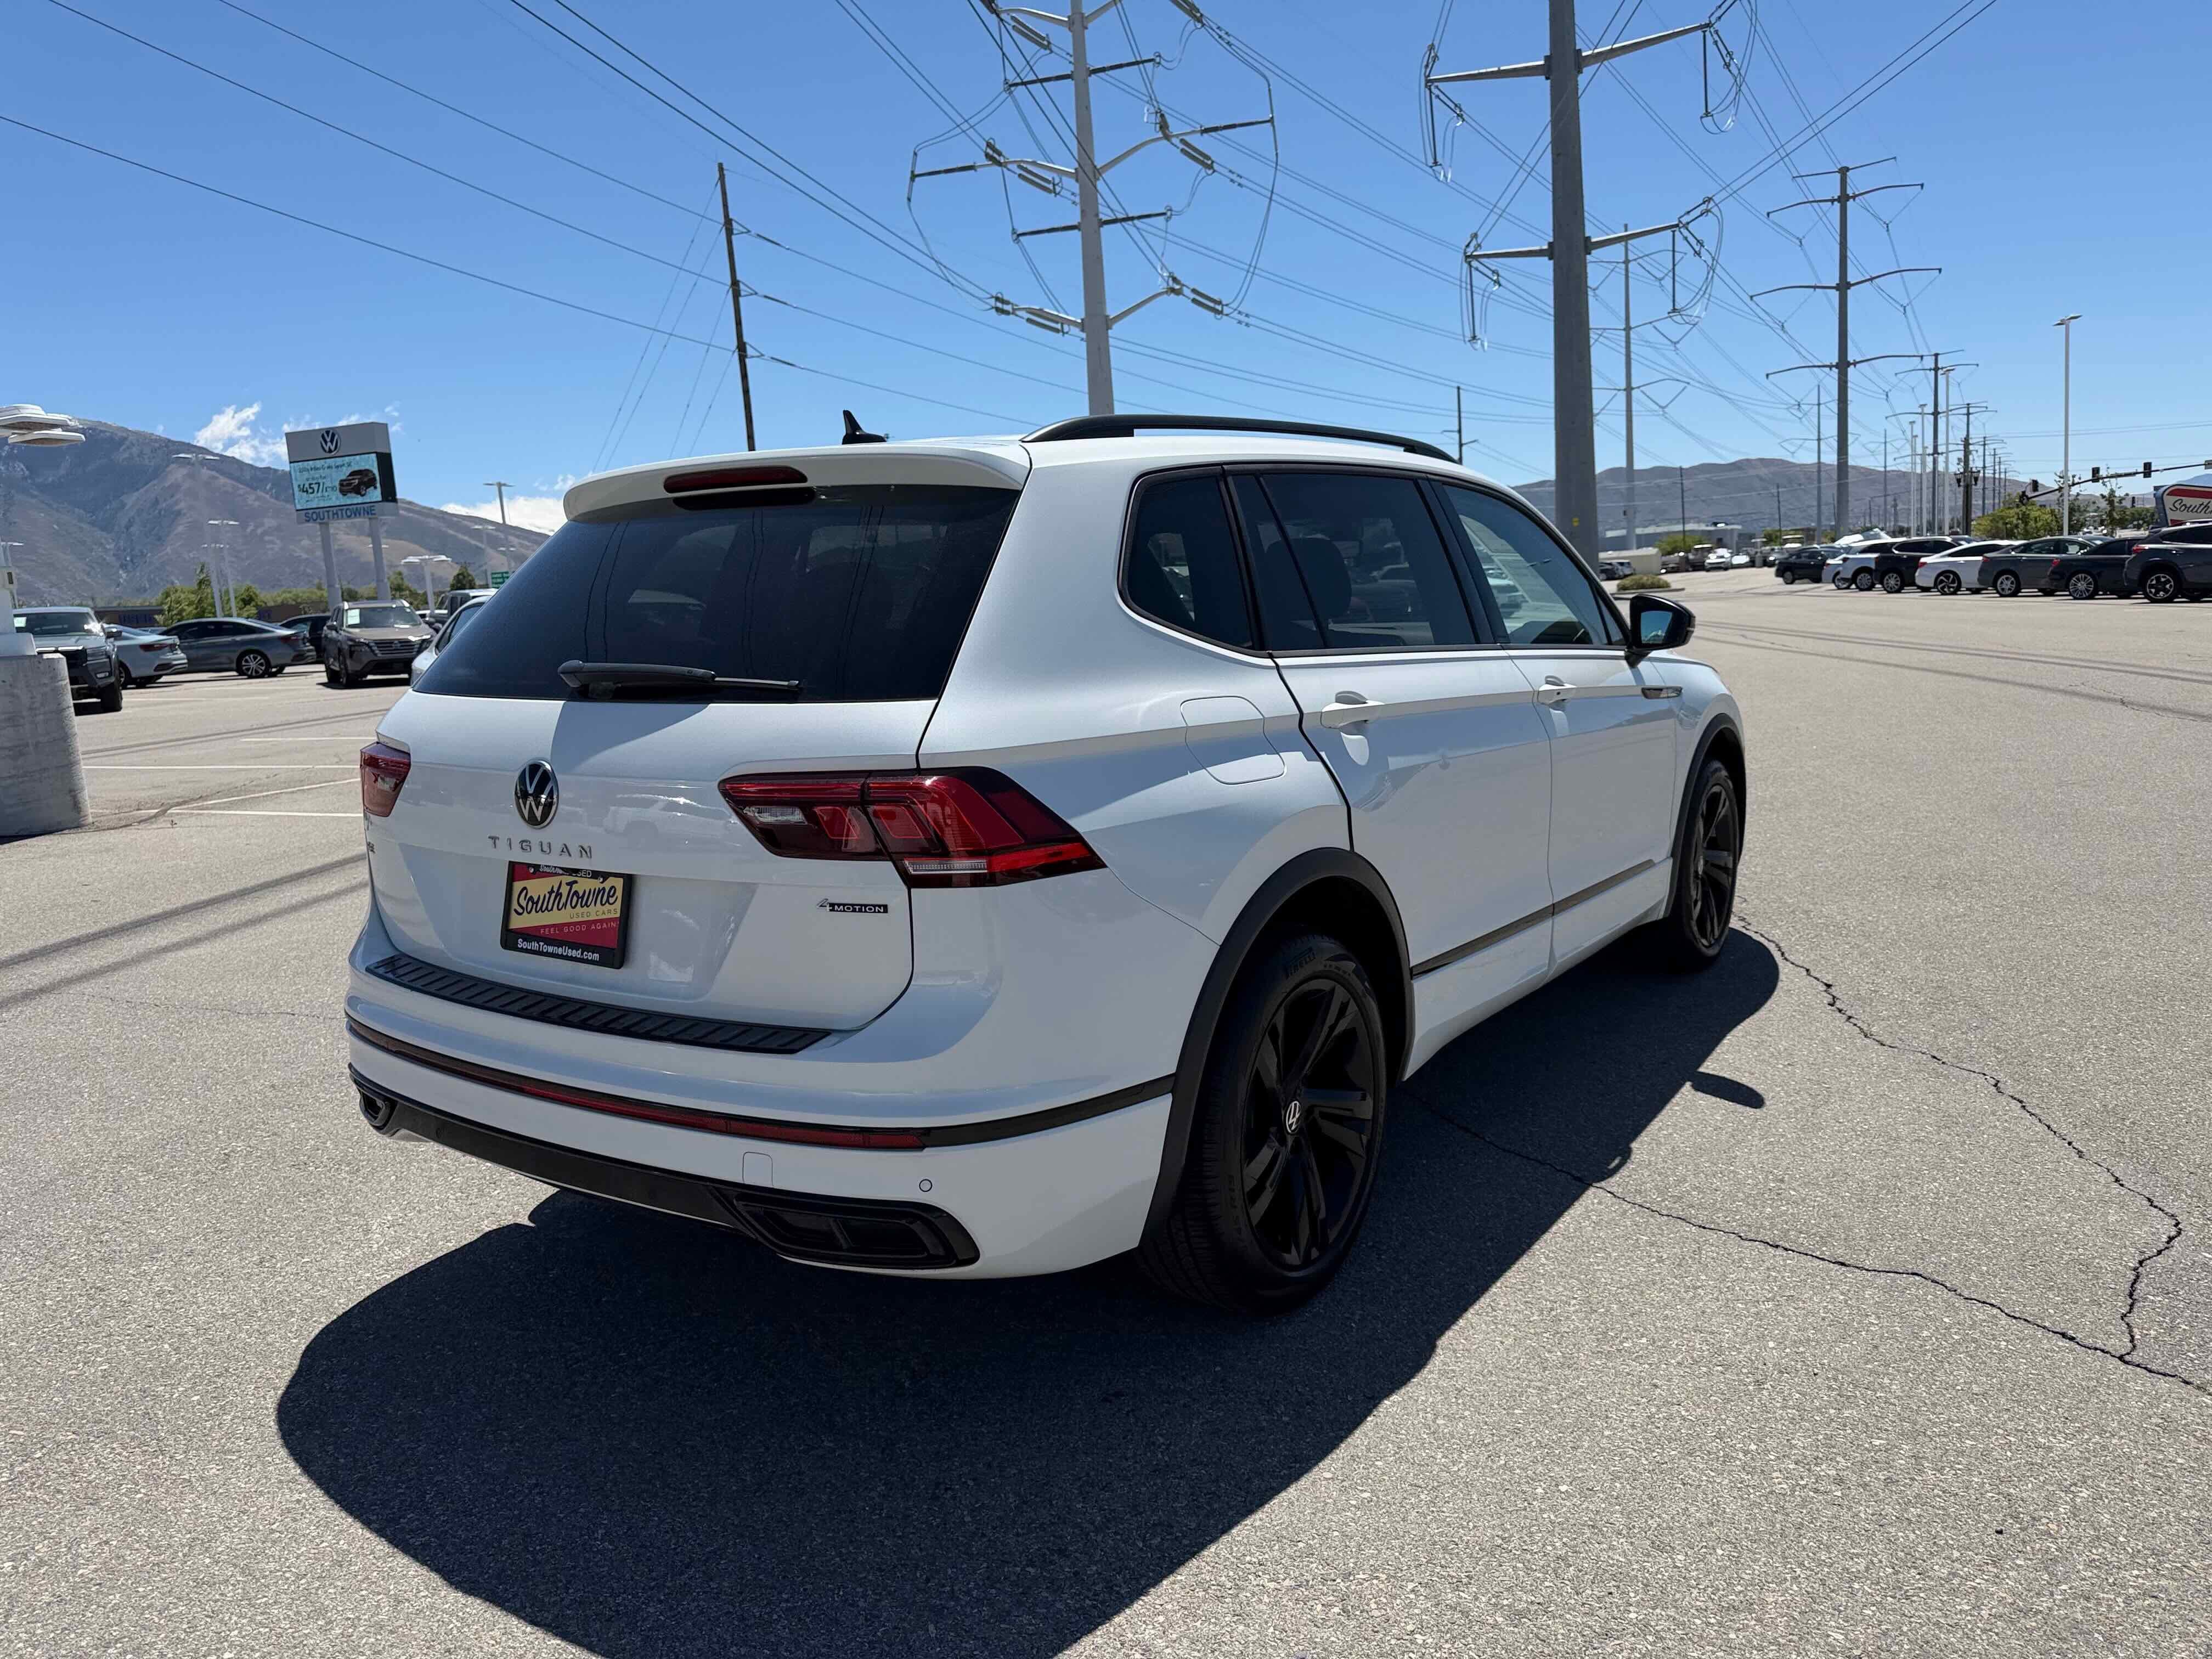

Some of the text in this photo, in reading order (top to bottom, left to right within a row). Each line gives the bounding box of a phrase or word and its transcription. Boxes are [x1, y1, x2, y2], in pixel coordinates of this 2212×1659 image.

[304, 505, 377, 522] SOUTHTOWNE
[2169, 498, 2212, 514] South
[488, 836, 592, 859] TIGUAN
[514, 879, 618, 916] SouthTowne
[816, 898, 884, 913] 4MOTION
[596, 908, 618, 917] CARS
[517, 938, 600, 961] SouthTowneUsed.com
